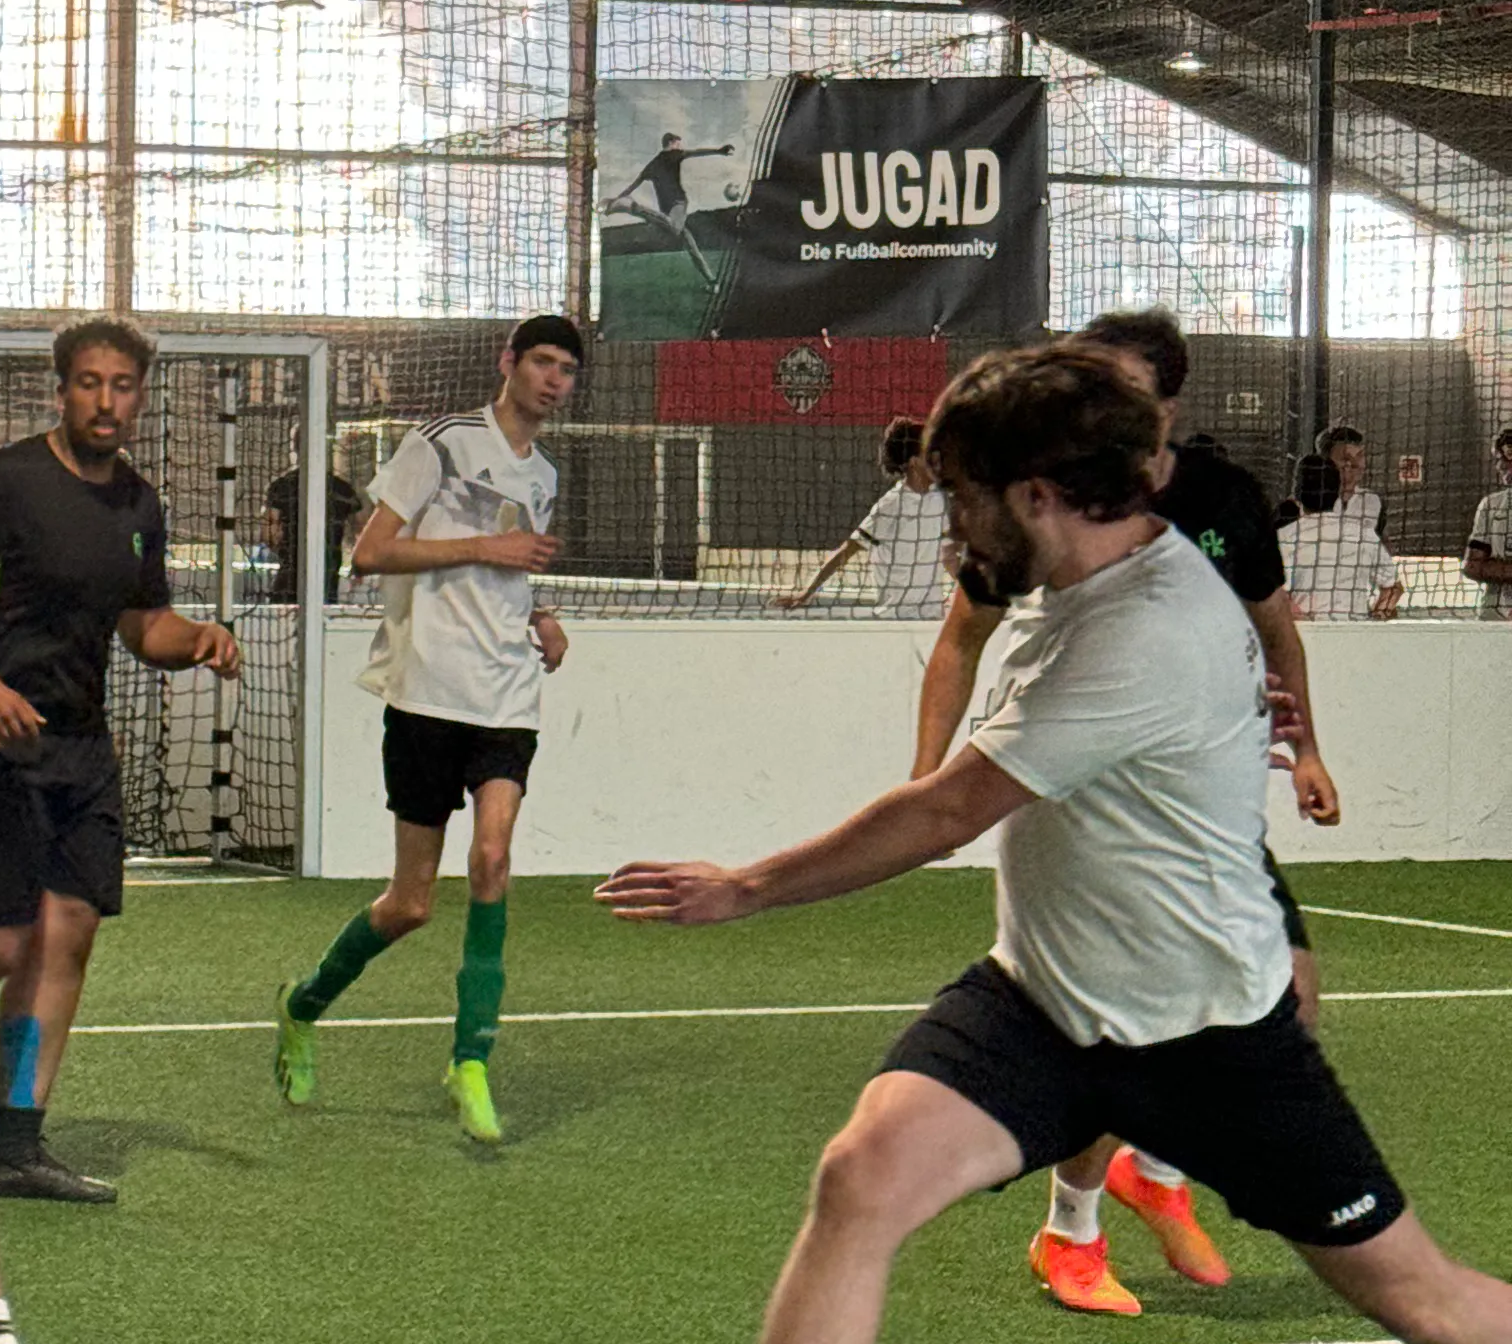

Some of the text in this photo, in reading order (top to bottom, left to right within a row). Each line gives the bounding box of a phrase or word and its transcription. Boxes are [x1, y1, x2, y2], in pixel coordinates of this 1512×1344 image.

[800, 148, 1001, 230] JUGAD
[800, 237, 998, 261] Die Fußballcommunity
[1330, 1194, 1376, 1227] JAKO
